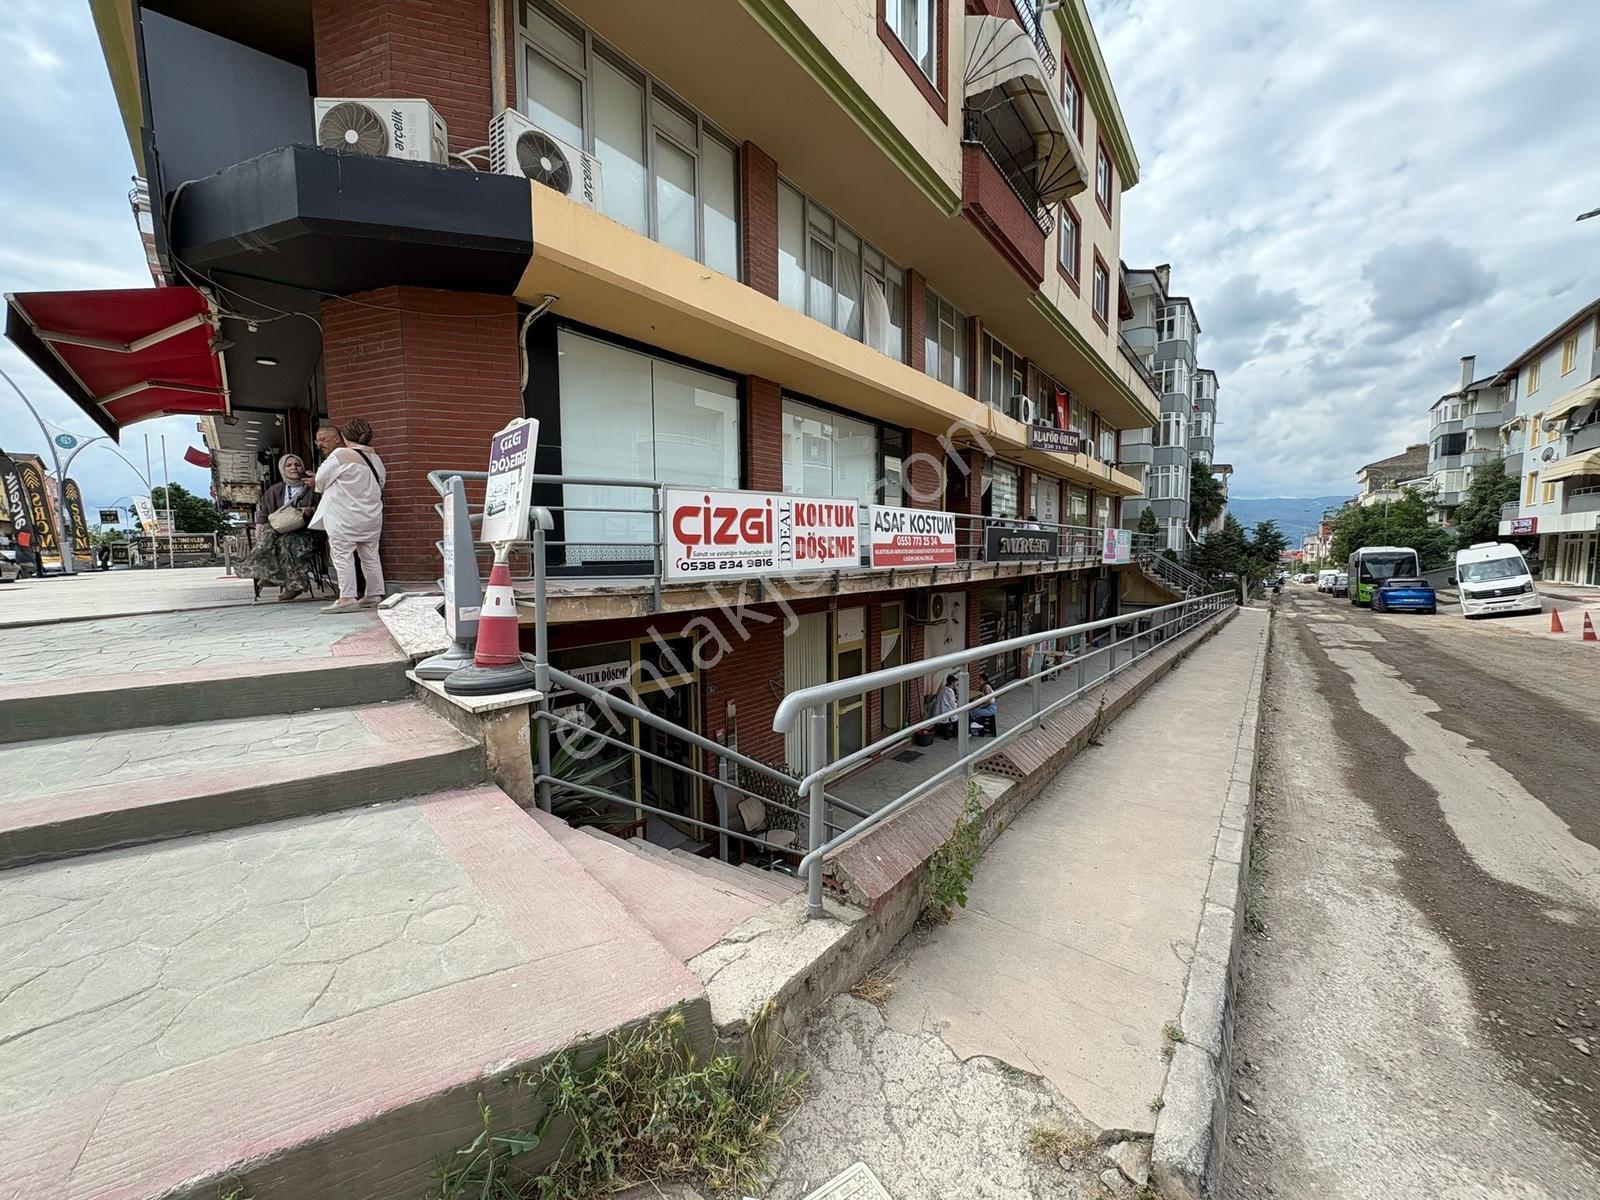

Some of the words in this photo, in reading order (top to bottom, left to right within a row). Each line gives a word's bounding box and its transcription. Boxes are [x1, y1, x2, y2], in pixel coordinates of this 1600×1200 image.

[391, 109, 406, 151] arçelik
[580, 152, 595, 203] arçelik
[5, 472, 26, 529] arçelik
[673, 495, 773, 559] ÇİZGİ
[795, 503, 855, 527] KOLTUK
[874, 511, 906, 533] ASAF
[910, 513, 953, 534] KOSTÜM
[795, 532, 855, 563] DÖŞEME
[896, 536, 911, 546] 0553
[912, 536, 922, 546] 773
[923, 537, 930, 546] 25
[930, 537, 938, 545] 34
[681, 562, 716, 571] 0538
[720, 560, 743, 569] 234
[747, 558, 773, 568] 9816
[573, 671, 600, 684] OLTUK
